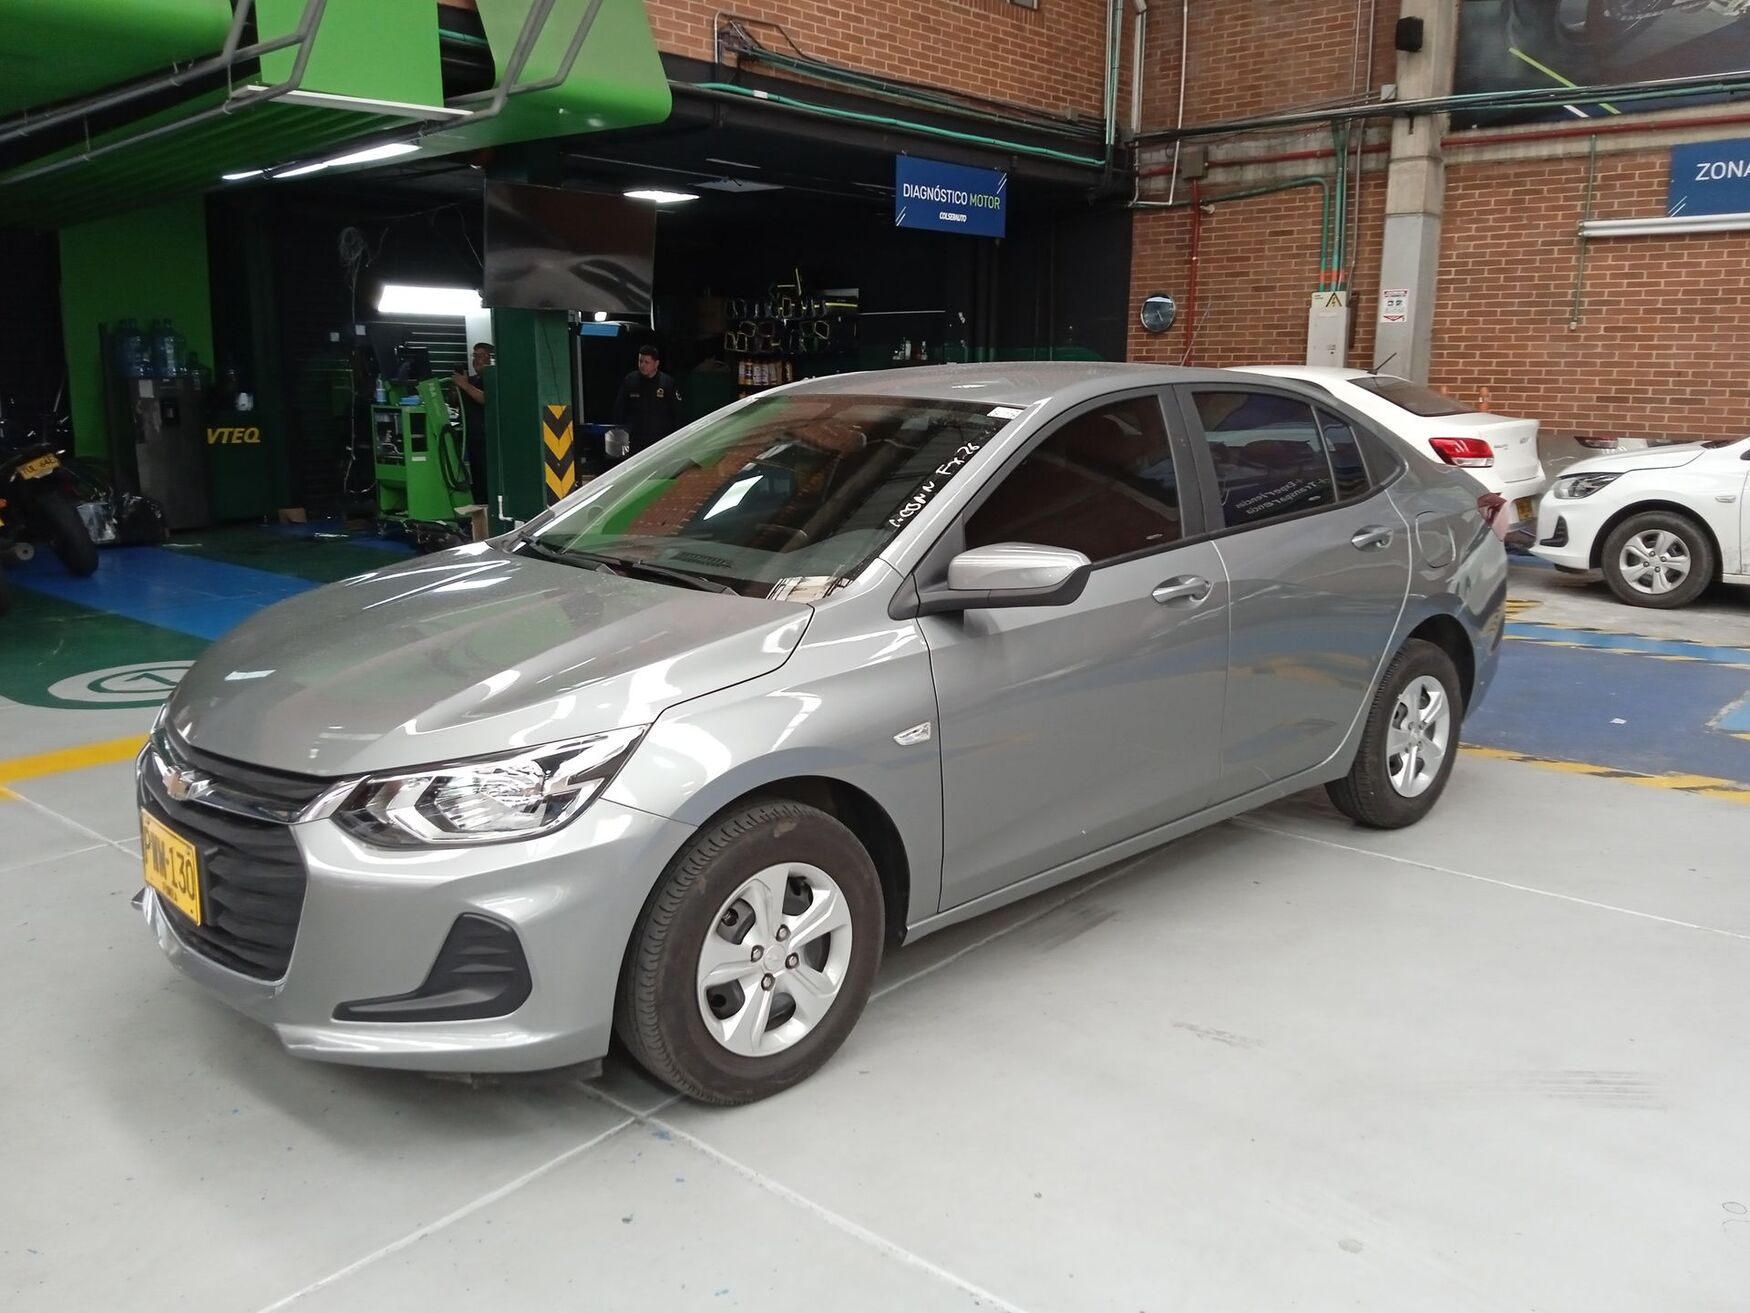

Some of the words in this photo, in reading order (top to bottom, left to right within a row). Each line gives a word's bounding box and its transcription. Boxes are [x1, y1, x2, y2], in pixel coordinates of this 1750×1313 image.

[903, 183, 968, 205] DIAGNÓSTICO
[969, 192, 1001, 210] MOTOR
[207, 427, 261, 444] VTEQ
